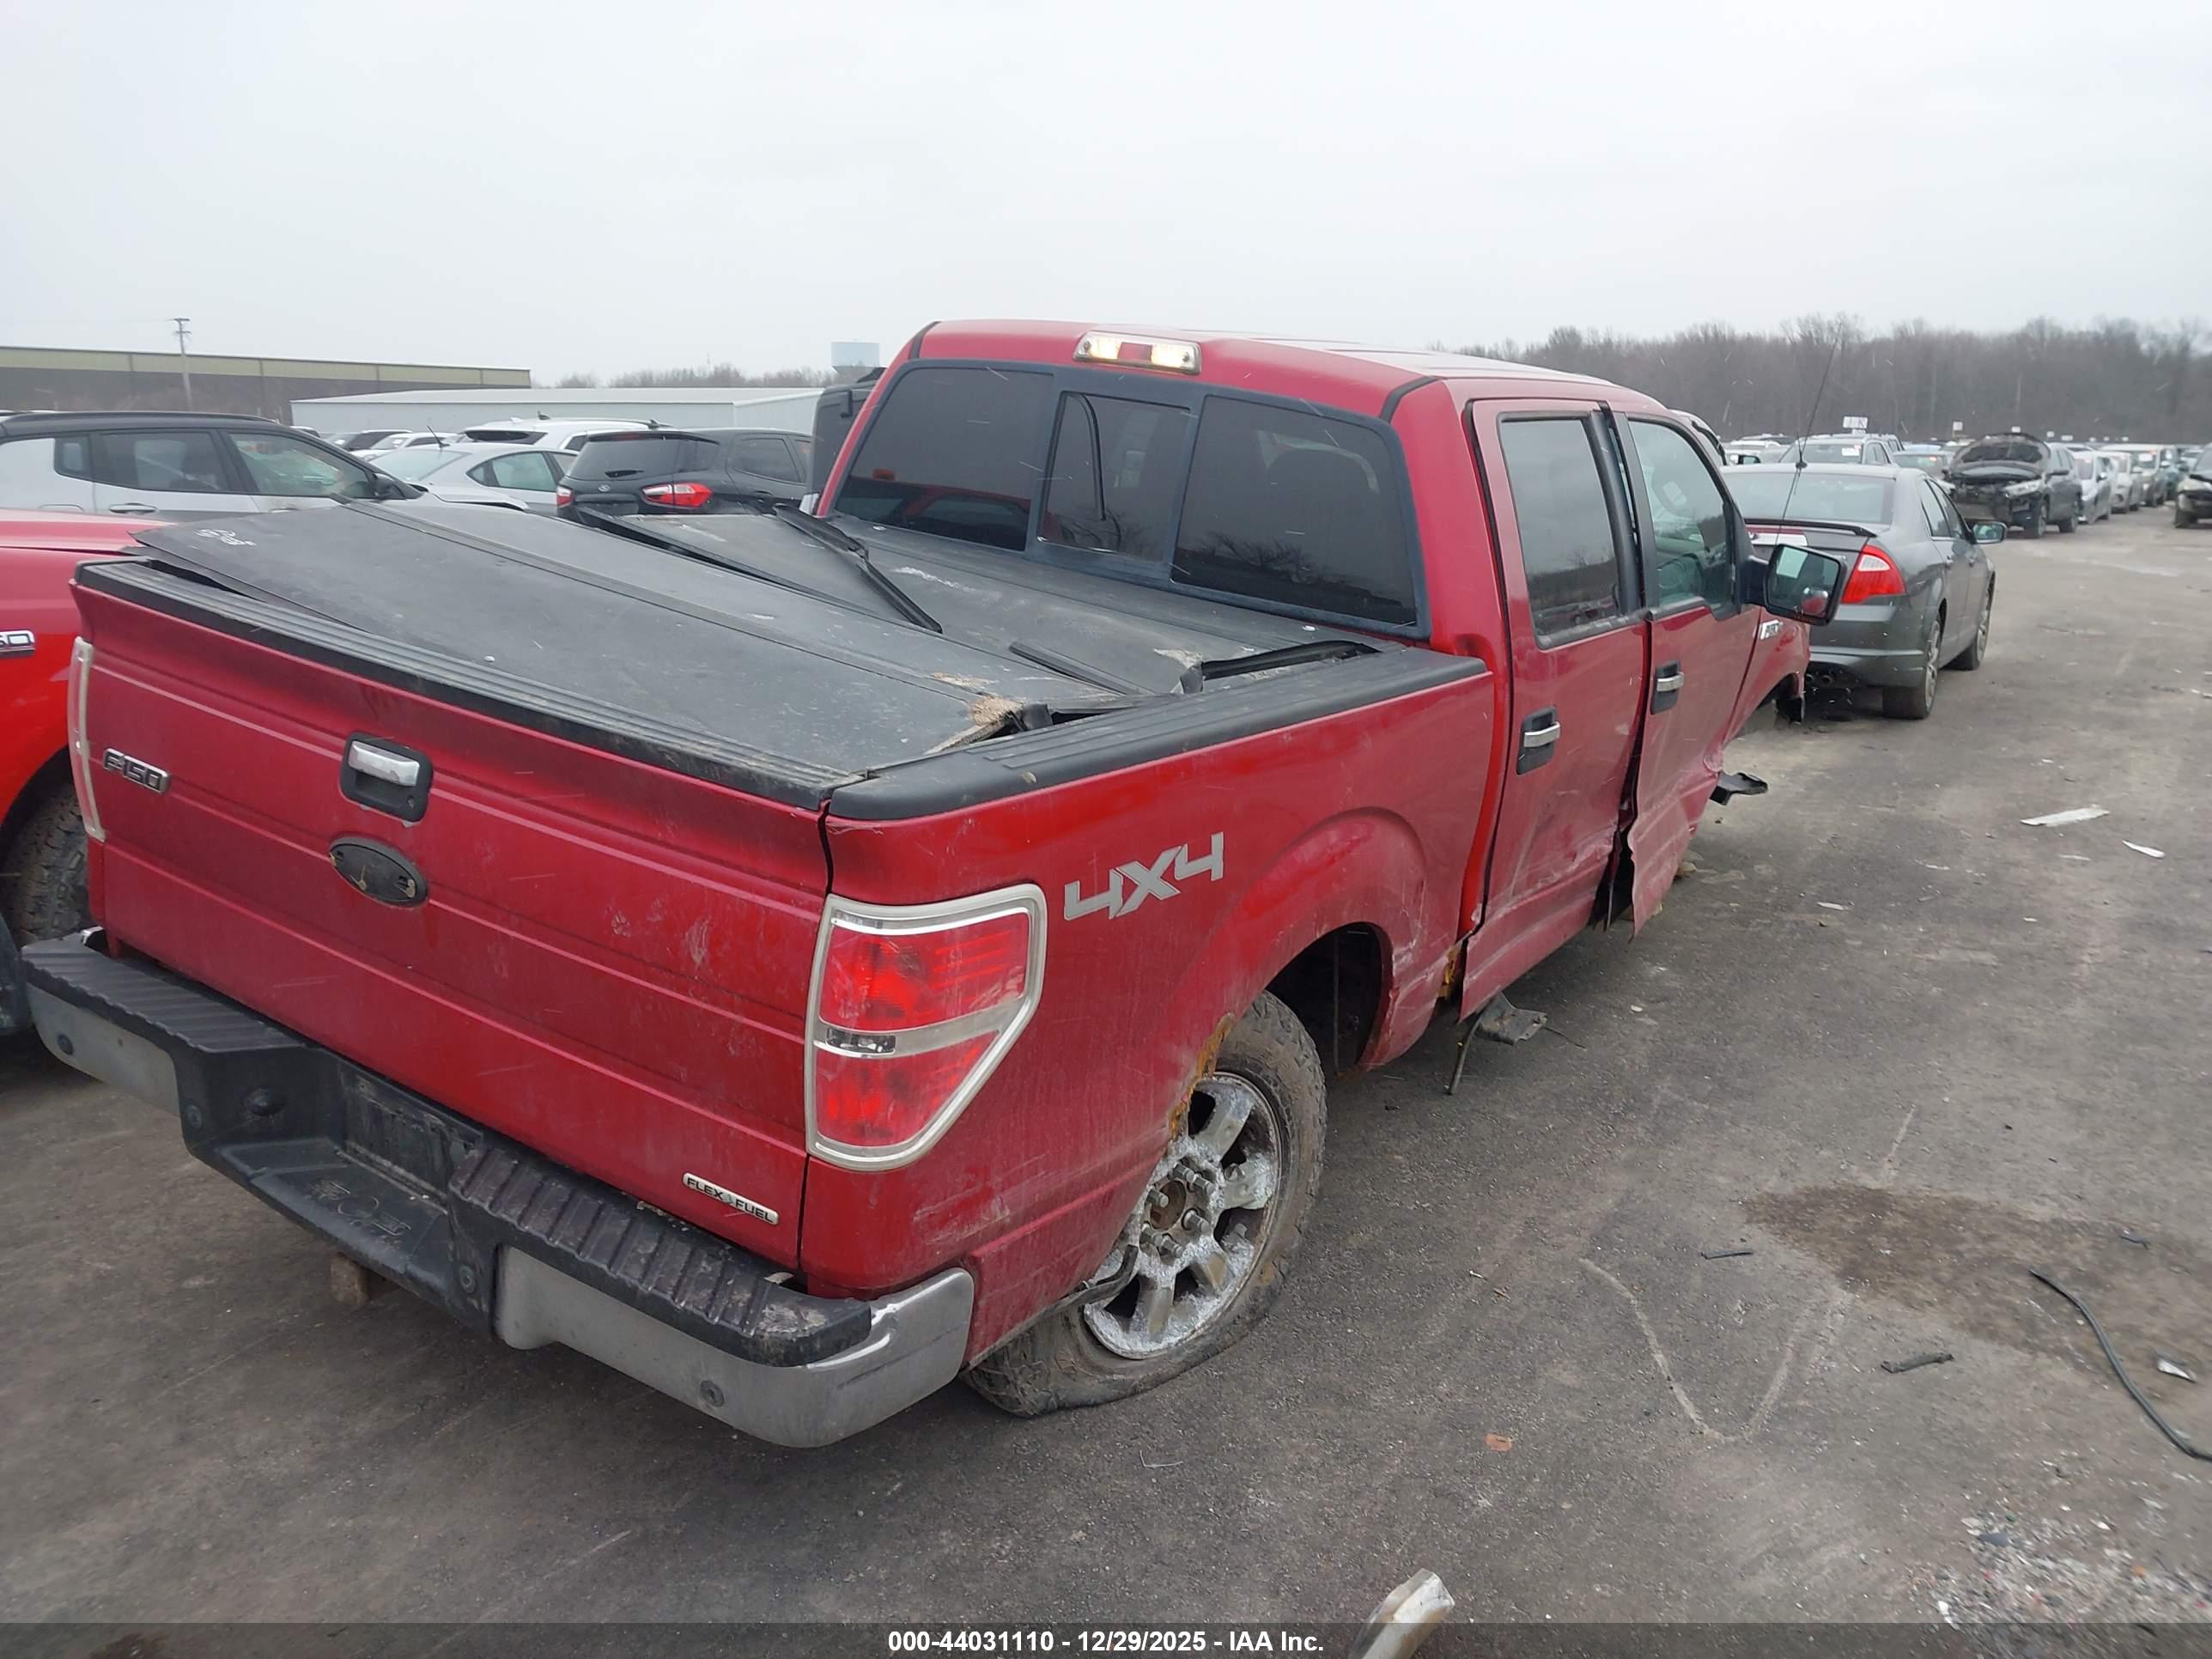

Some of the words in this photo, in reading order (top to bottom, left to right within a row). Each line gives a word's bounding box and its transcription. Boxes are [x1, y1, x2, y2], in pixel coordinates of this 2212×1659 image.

[1064, 831, 1224, 921] 4X4
[686, 1176, 724, 1200] FLEX
[735, 1198, 775, 1224] FUEL
